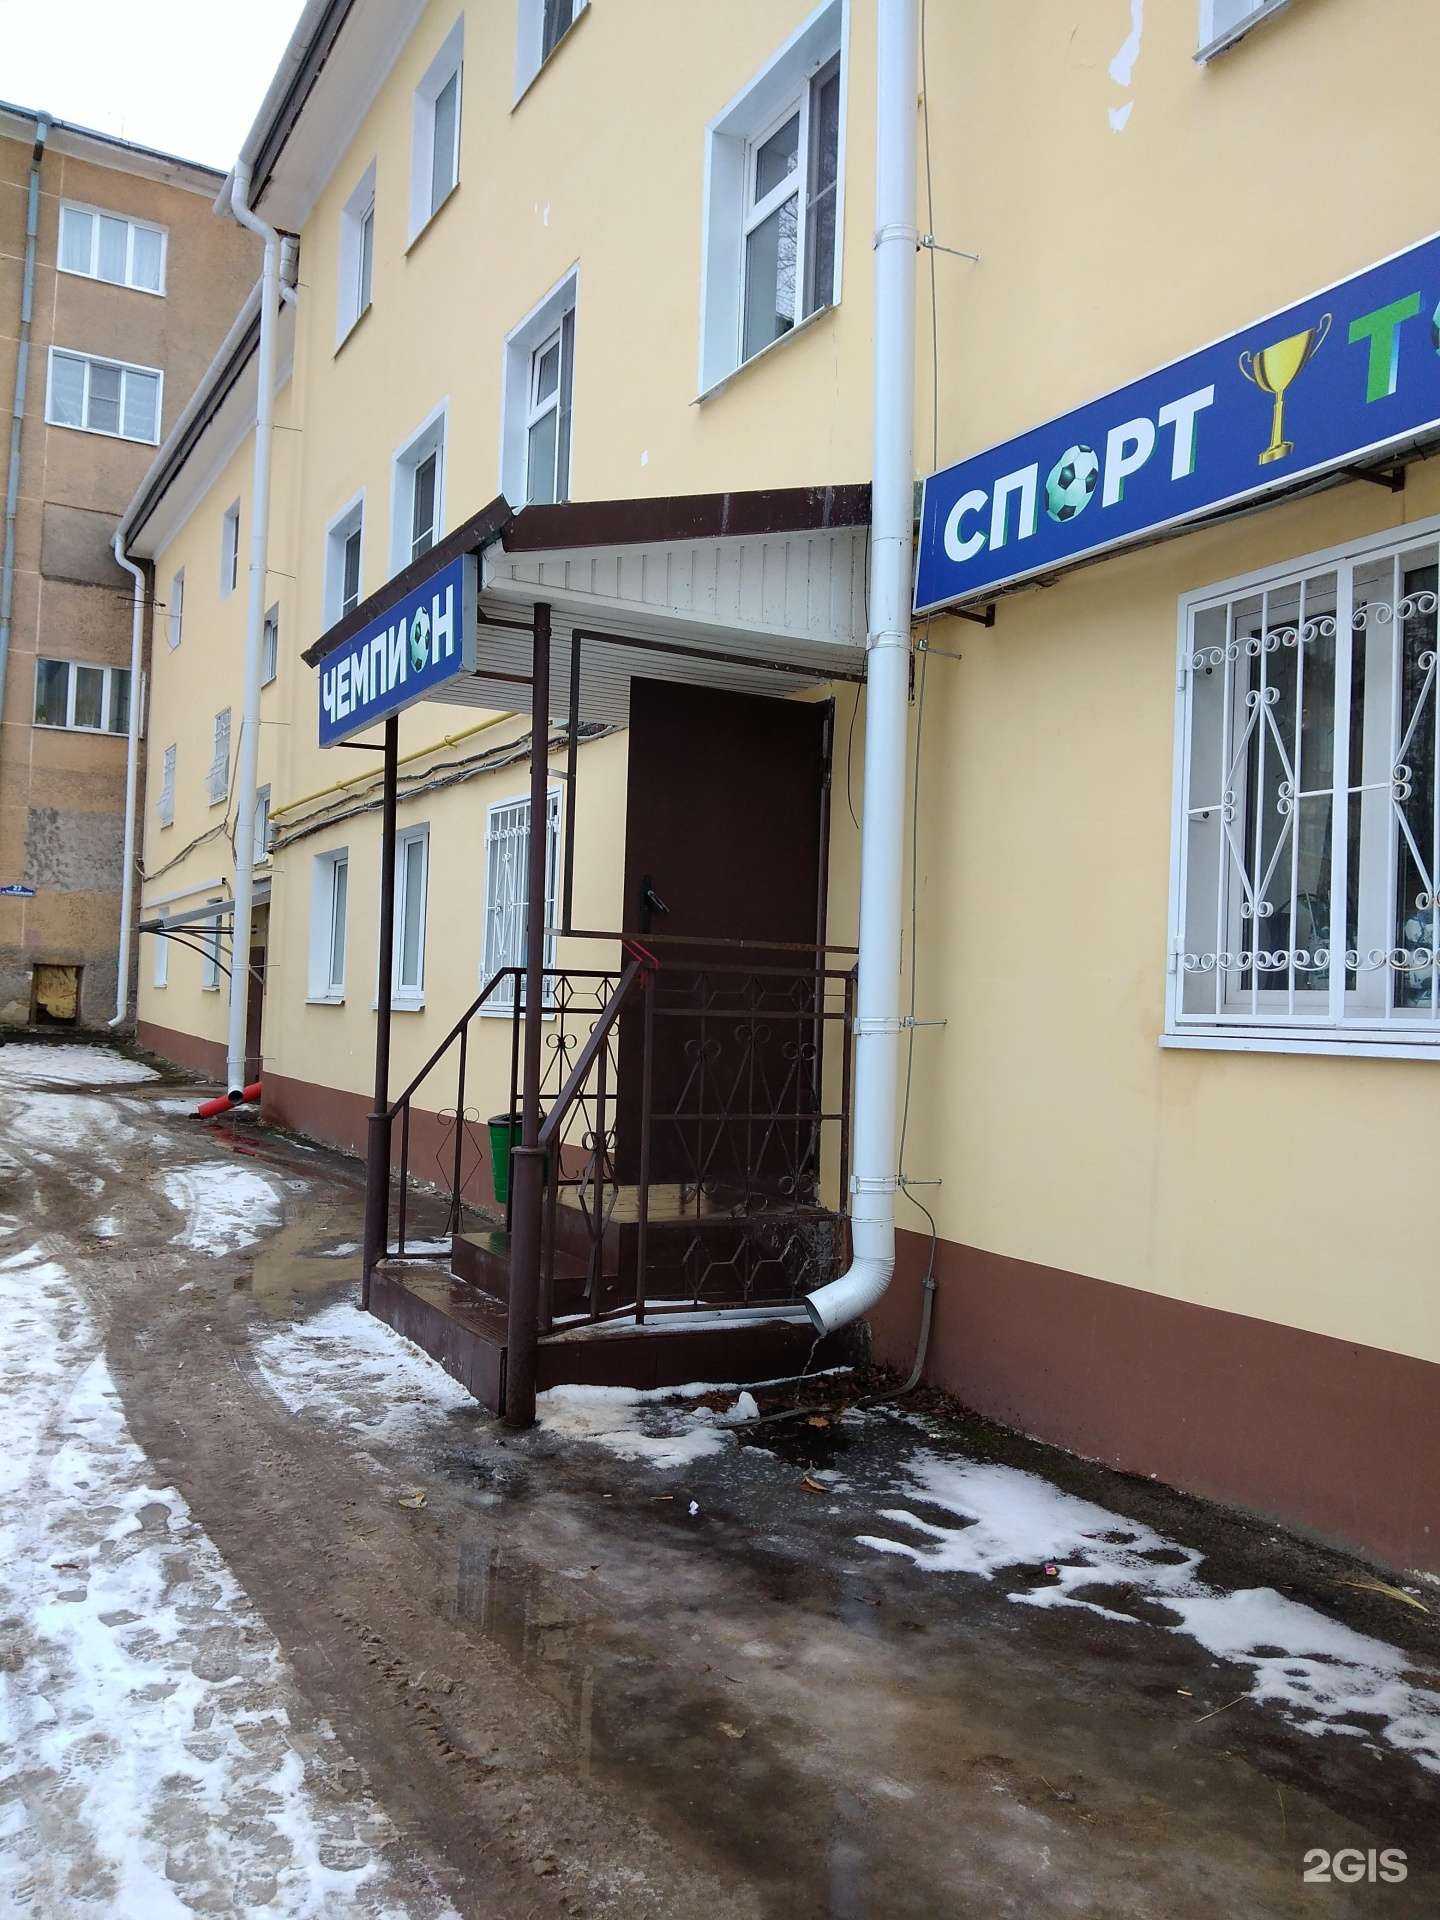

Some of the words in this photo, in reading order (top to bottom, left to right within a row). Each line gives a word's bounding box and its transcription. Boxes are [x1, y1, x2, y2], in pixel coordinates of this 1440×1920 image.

[943, 383, 1216, 563] СПОРТ
[1347, 290, 1440, 404] Т
[322, 583, 454, 725] ЧЕМПИОН
